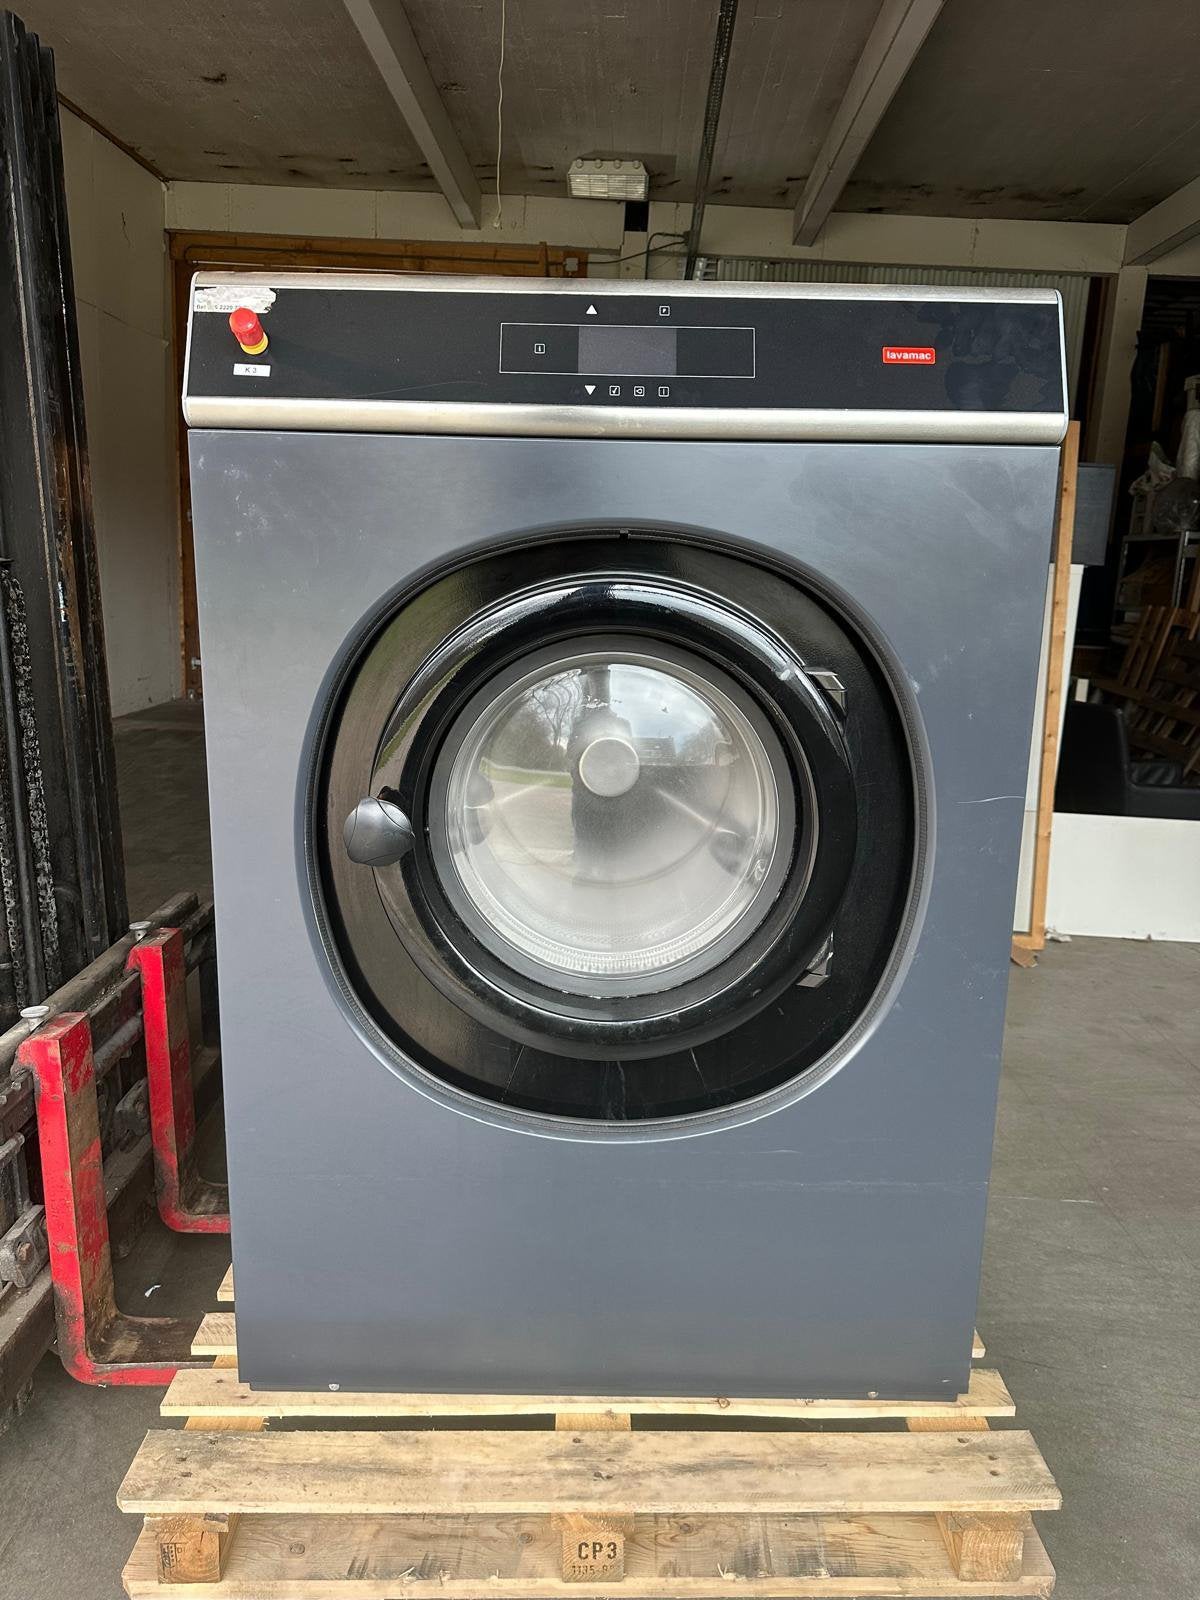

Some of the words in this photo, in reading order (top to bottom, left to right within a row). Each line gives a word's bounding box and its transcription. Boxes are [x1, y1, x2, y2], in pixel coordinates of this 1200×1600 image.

[886, 350, 932, 360] lavamac
[244, 366, 251, 374] K
[577, 1541, 618, 1560] CP3
